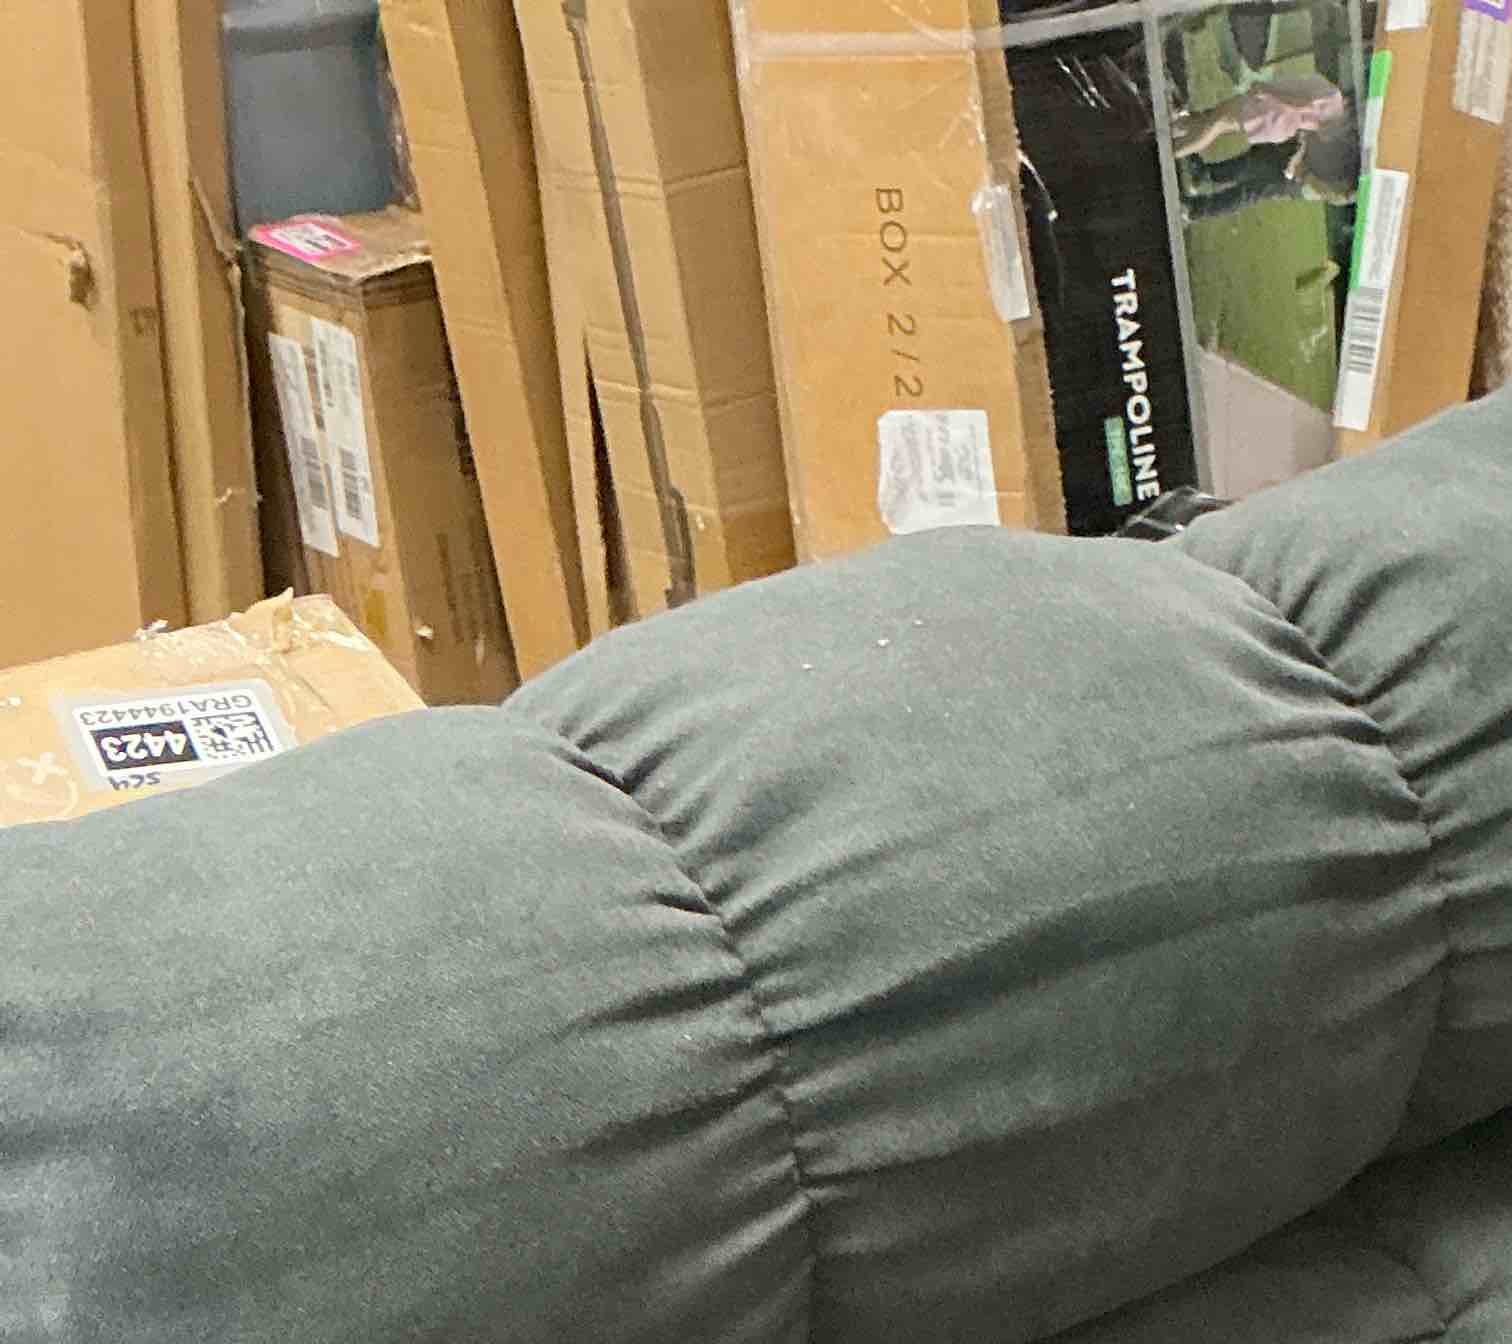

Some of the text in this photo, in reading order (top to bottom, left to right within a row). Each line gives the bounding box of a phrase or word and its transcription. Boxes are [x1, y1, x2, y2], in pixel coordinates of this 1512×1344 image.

[876, 188, 912, 286] BOX
[1111, 268, 1161, 501] TRAMPOLINE
[80, 695, 252, 726] GRA1944423
[101, 730, 187, 762] 4423
